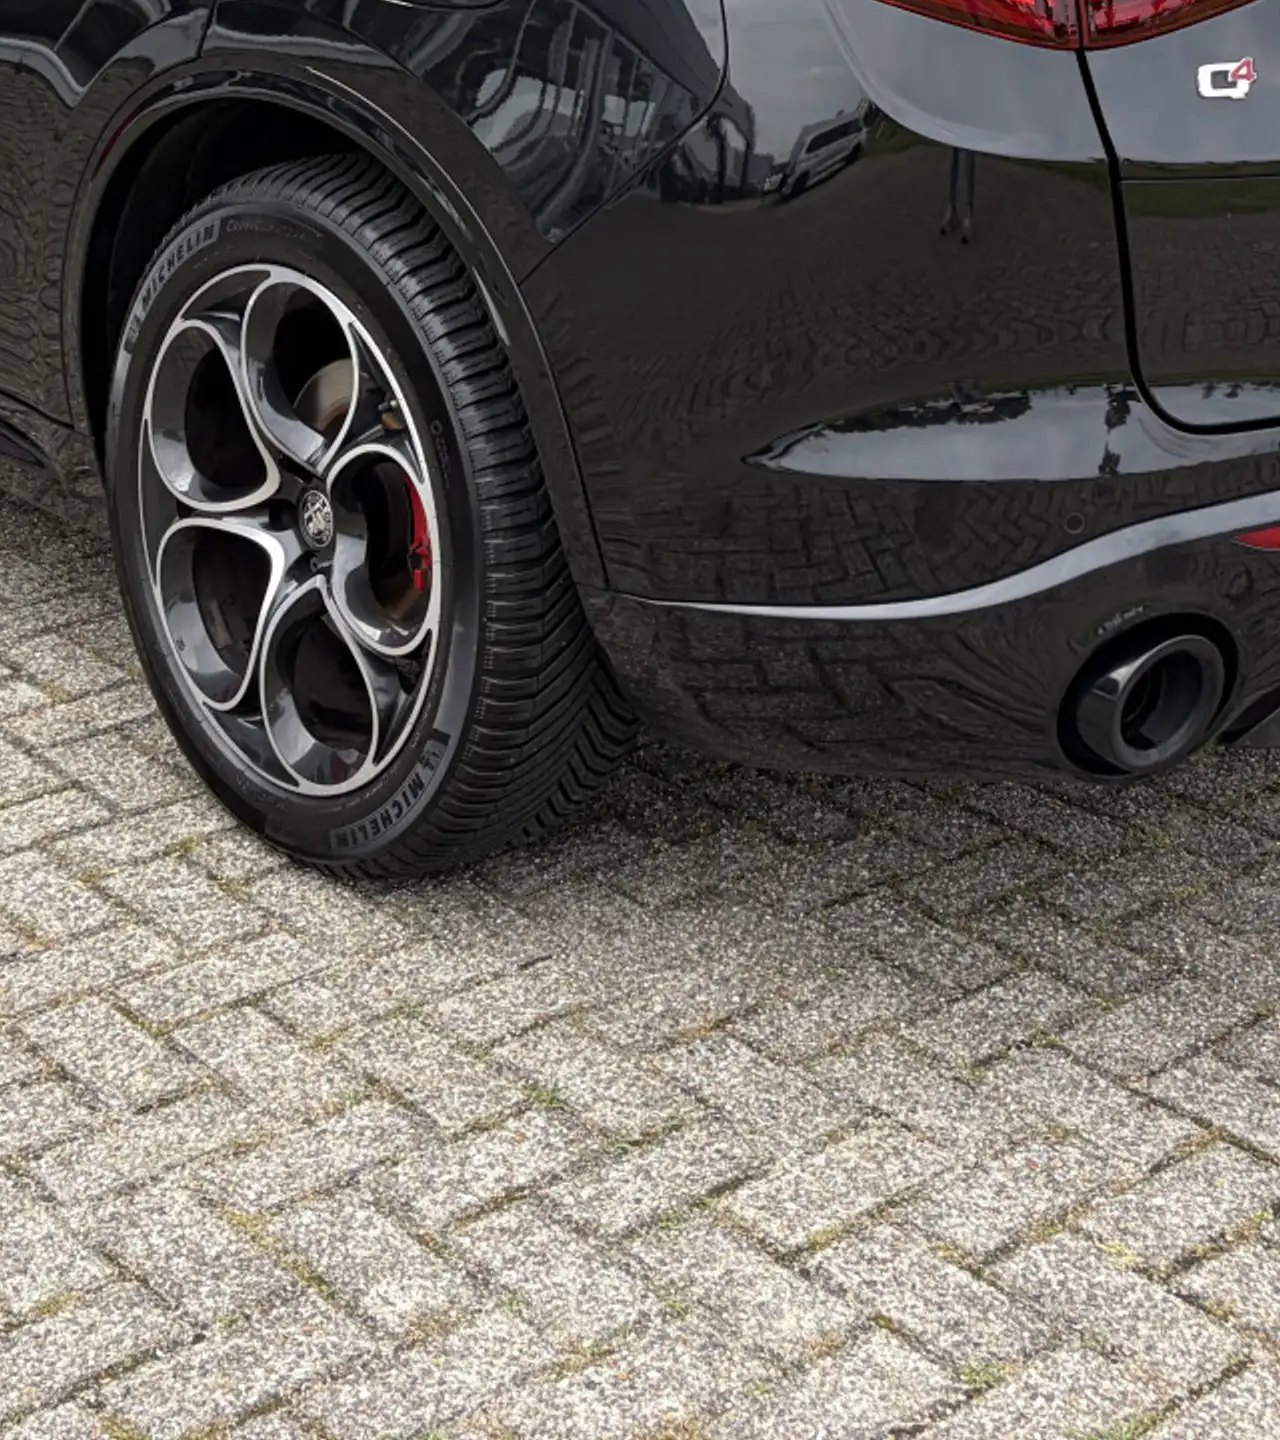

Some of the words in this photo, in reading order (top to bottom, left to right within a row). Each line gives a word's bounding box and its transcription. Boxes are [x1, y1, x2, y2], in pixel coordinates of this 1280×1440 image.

[1197, 57, 1257, 99] Q4
[140, 223, 214, 311] MICHELIN
[335, 771, 426, 848] MICHELIN
